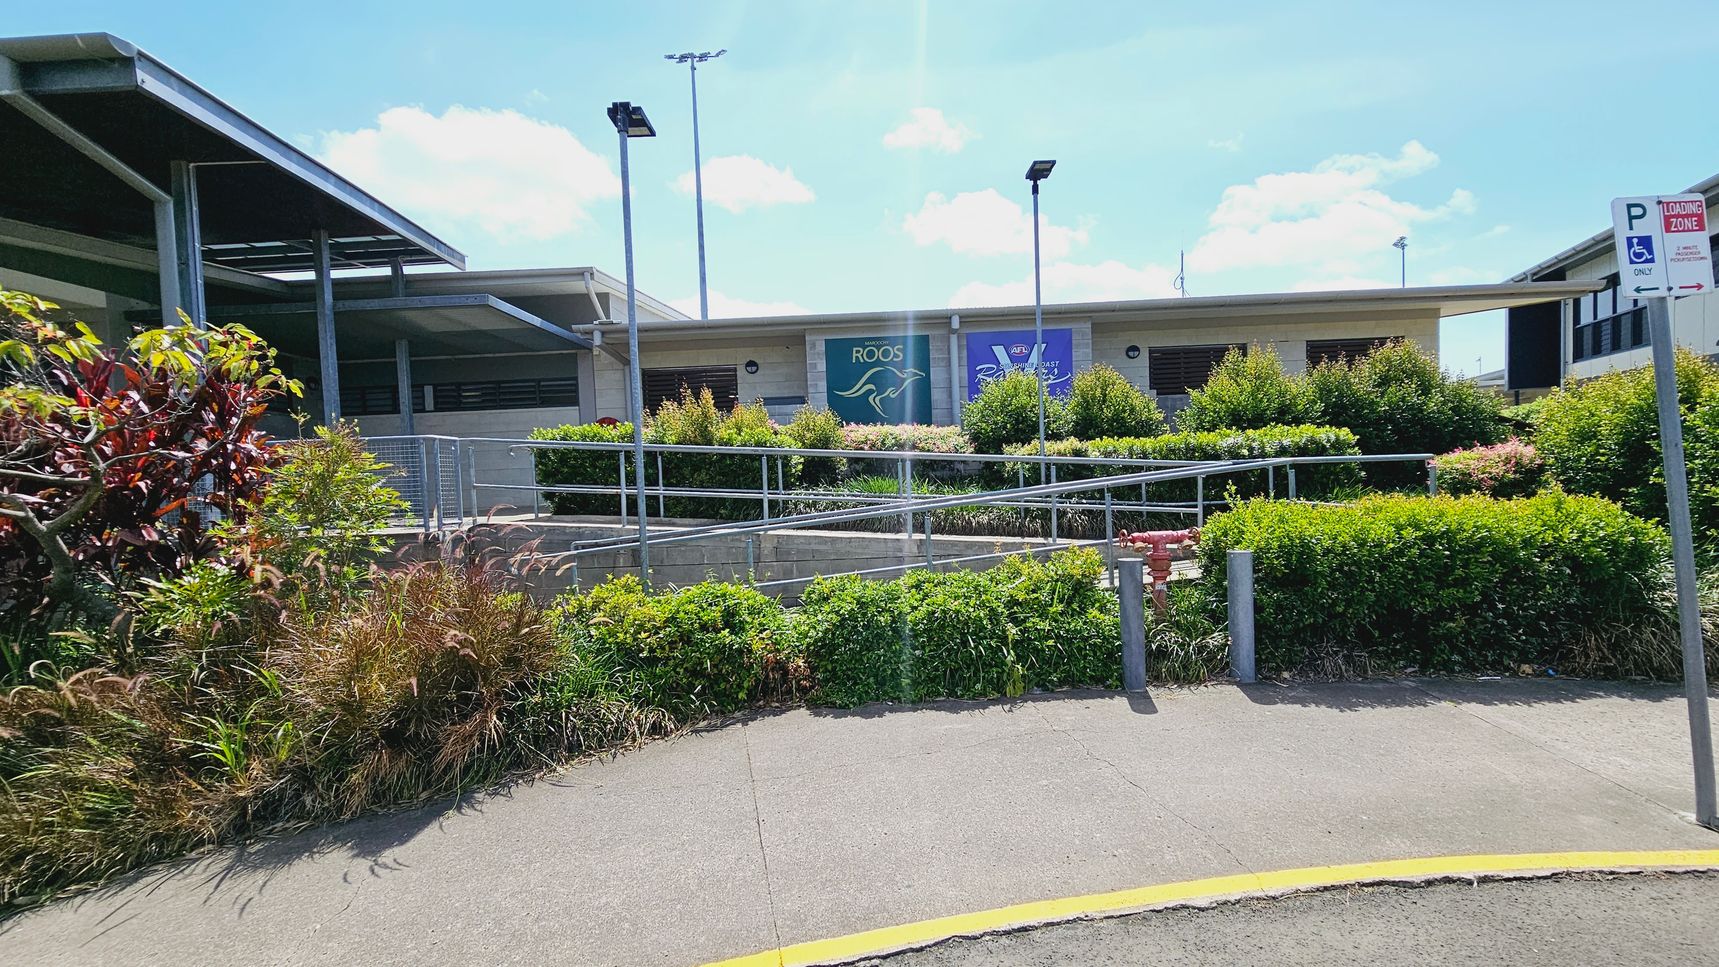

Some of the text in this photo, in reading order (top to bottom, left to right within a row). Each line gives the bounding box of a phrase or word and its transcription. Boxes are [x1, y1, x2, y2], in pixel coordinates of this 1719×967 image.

[1663, 202, 1702, 215] LOADING
[1626, 203, 1647, 231] P
[1670, 218, 1699, 231] ZONE
[1634, 267, 1652, 276] ONLY
[852, 345, 904, 363] ROOS
[1011, 346, 1028, 354] AFL
